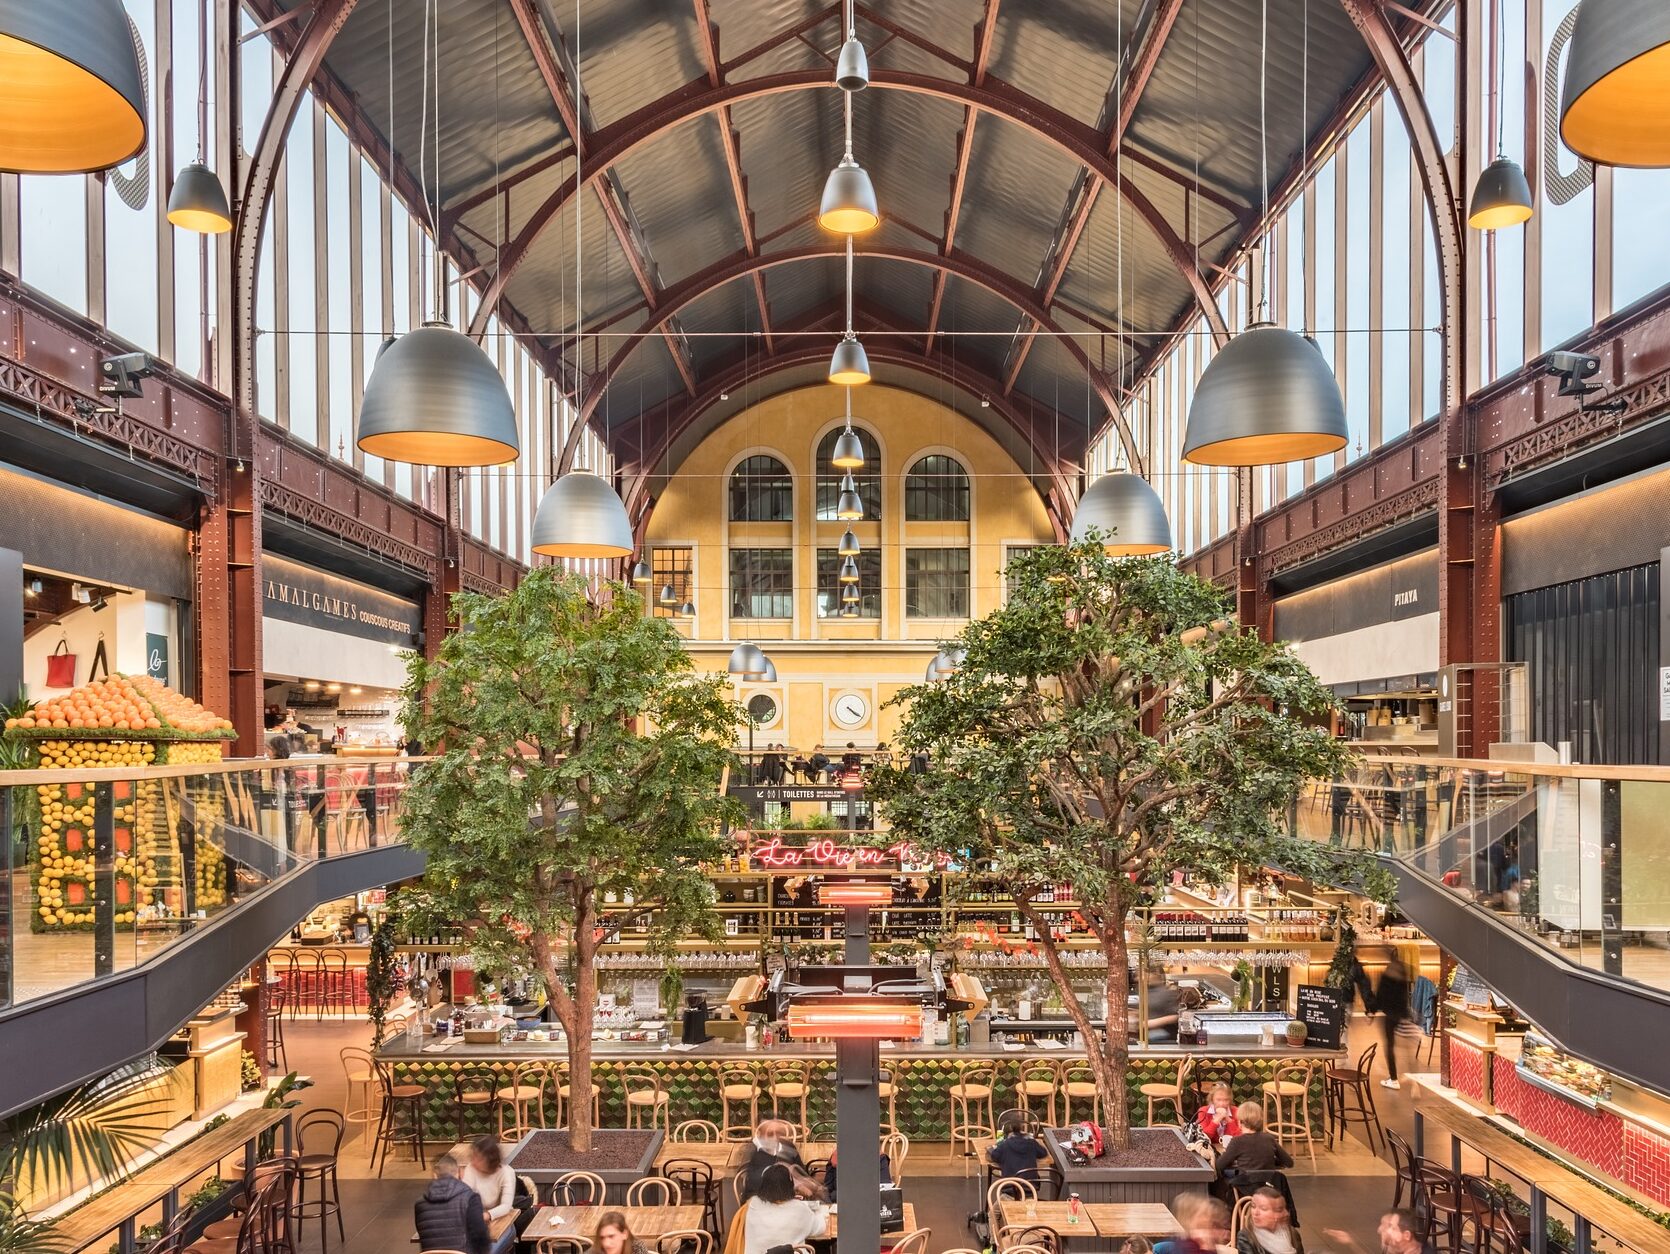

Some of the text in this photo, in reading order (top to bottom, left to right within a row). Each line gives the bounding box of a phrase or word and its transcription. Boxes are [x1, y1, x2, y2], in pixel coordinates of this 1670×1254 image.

[267, 580, 357, 620] AMALGAMES
[359, 610, 389, 629] COUSCOUS
[1394, 589, 1418, 606] PITAYA
[782, 790, 815, 798] TOILETTES
[751, 838, 801, 865] La
[802, 840, 855, 866] Vie
[858, 847, 889, 863] en
